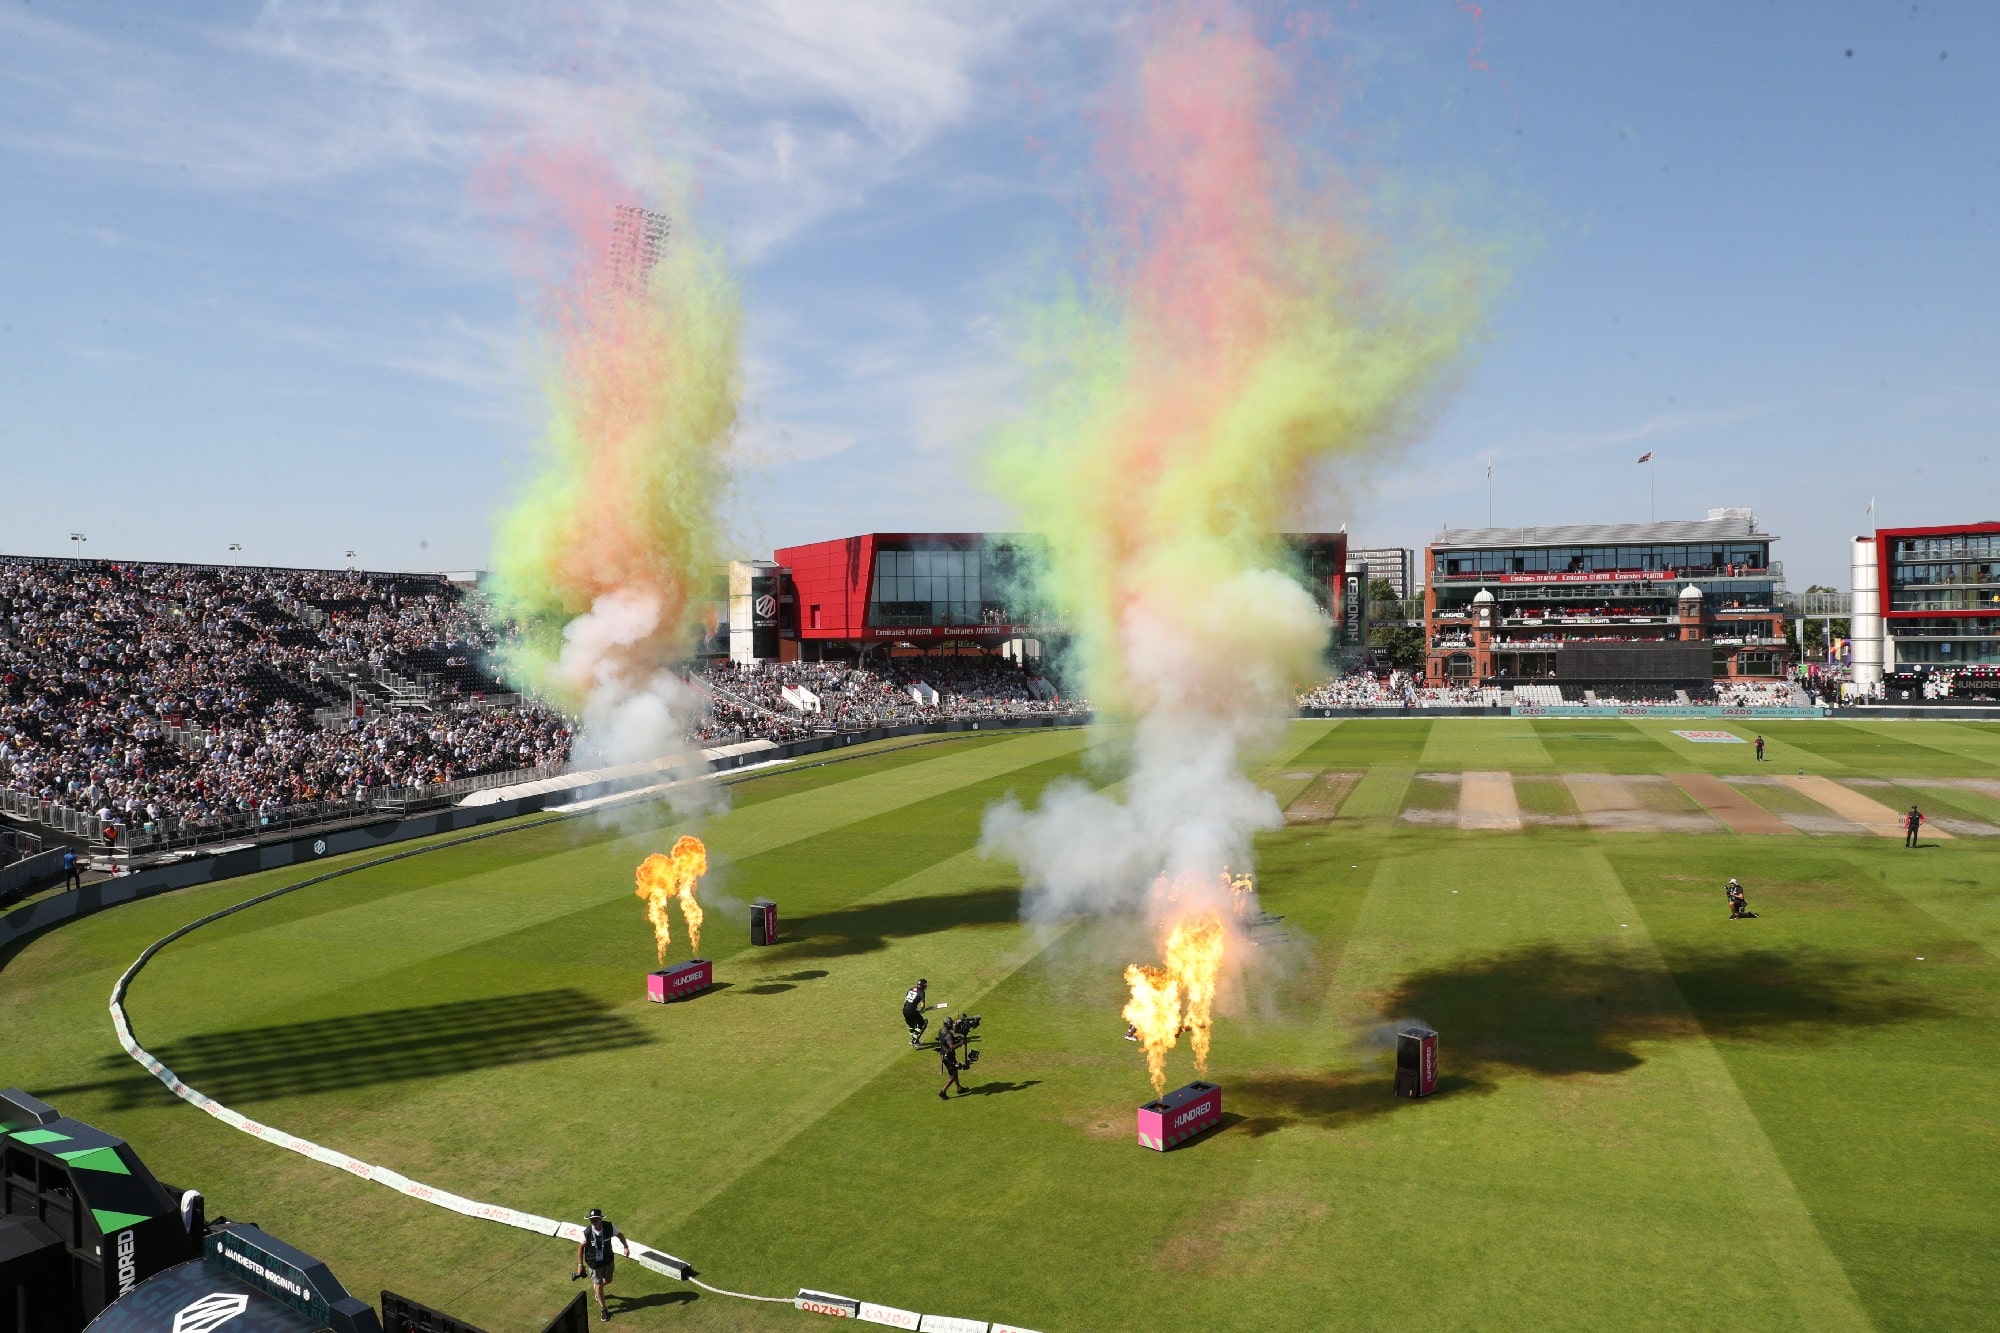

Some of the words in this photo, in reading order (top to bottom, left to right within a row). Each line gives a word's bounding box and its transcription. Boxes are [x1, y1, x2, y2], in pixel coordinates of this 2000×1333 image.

[1348, 576, 1358, 641] HUNDRED
[673, 970, 703, 988] HUNDRED
[1174, 1101, 1211, 1128] HUNDRED
[242, 1122, 262, 1134] CAZOO
[346, 1161, 370, 1176] CAZOO
[406, 1184, 433, 1199] CAZOO
[476, 1207, 511, 1221] CAZOO
[118, 1230, 136, 1296] NDRED
[225, 1248, 264, 1276] MANCHESTER
[265, 1268, 301, 1296] ORIGINALS
[802, 1302, 847, 1318] CAZOO
[865, 1308, 911, 1326] CAZOO
